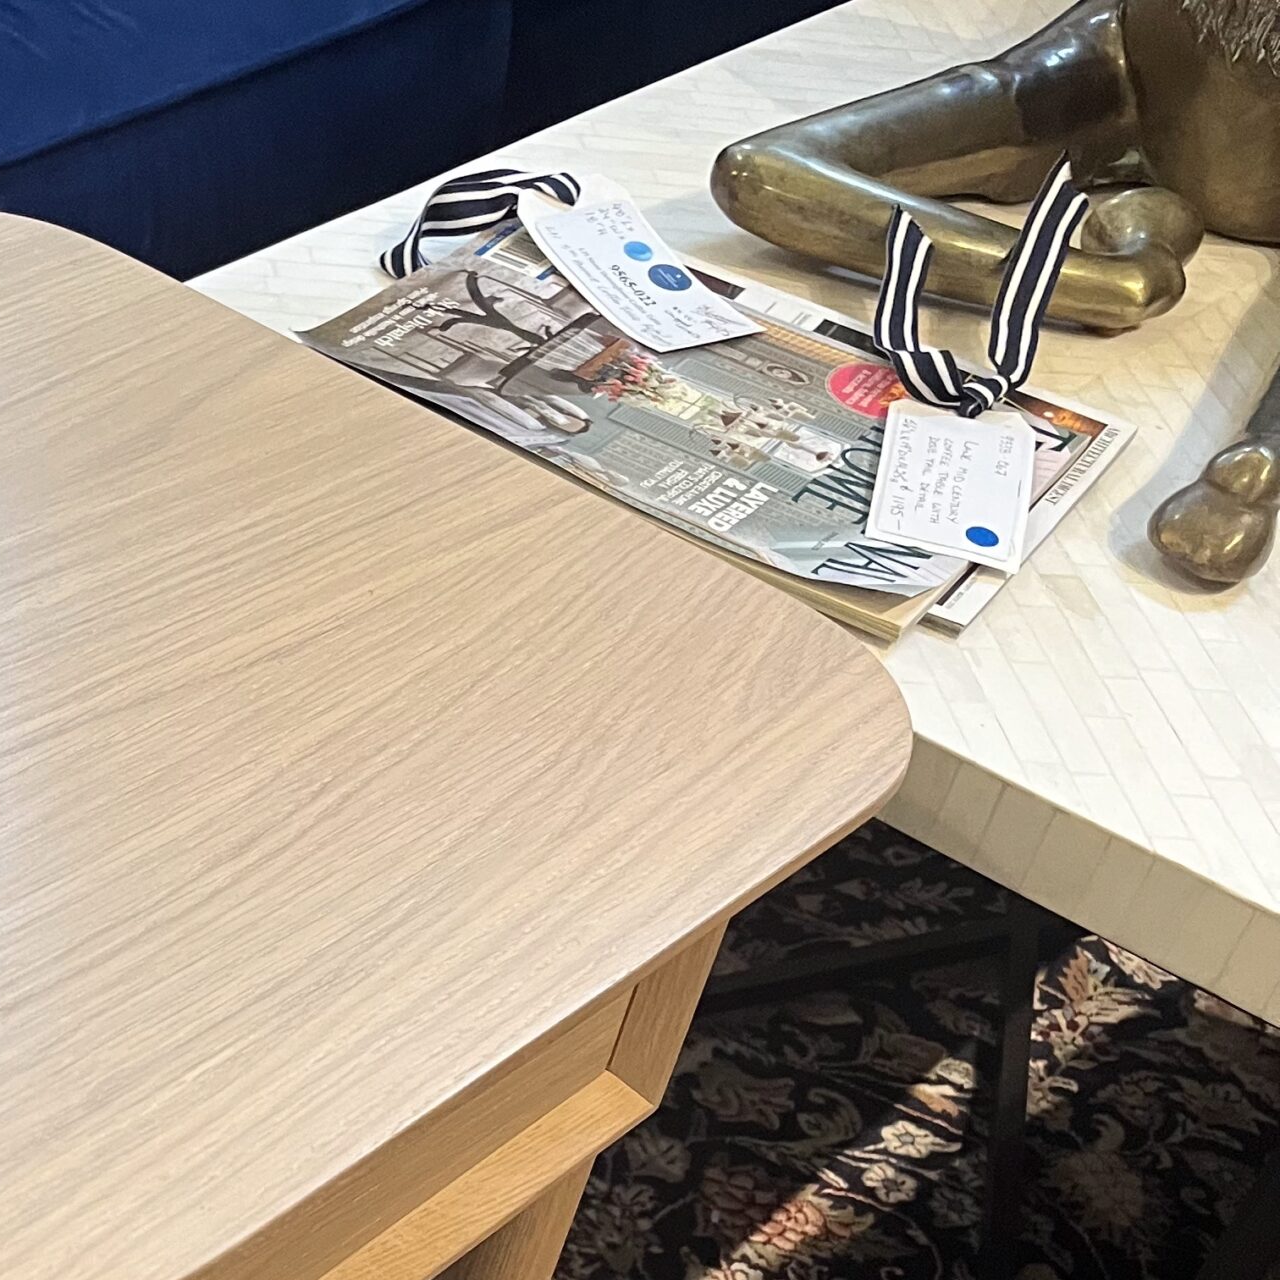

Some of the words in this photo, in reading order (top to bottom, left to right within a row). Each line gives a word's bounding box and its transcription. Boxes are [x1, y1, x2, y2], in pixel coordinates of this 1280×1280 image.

[373, 314, 433, 347] Dispatch
[639, 477, 658, 489] YOU
[722, 477, 748, 491] &
[687, 486, 738, 517] LUXE
[707, 481, 779, 532] LAYERED
